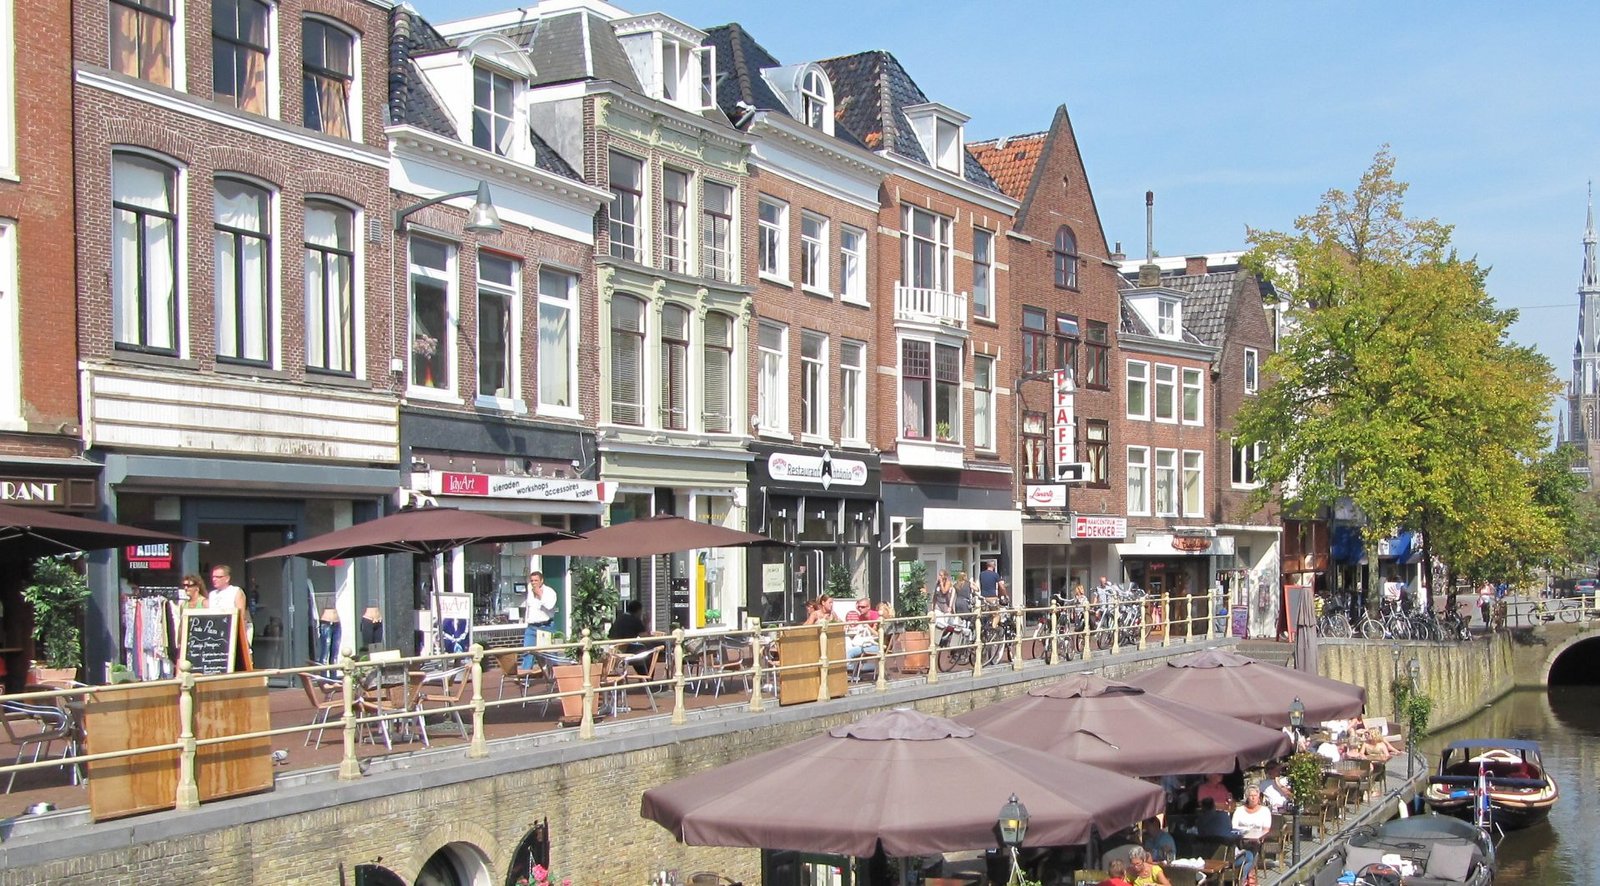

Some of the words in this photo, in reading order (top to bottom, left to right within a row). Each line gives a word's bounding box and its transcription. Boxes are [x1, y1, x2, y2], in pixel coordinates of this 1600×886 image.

[787, 463, 820, 477] Restaurant
[0, 481, 57, 501] RANT
[450, 475, 475, 491] IdyArt
[493, 481, 520, 493] sieraden
[516, 482, 549, 495] workshops
[545, 484, 579, 496] accessoires
[575, 488, 594, 498] kralen
[1088, 526, 1116, 537] DEKKER
